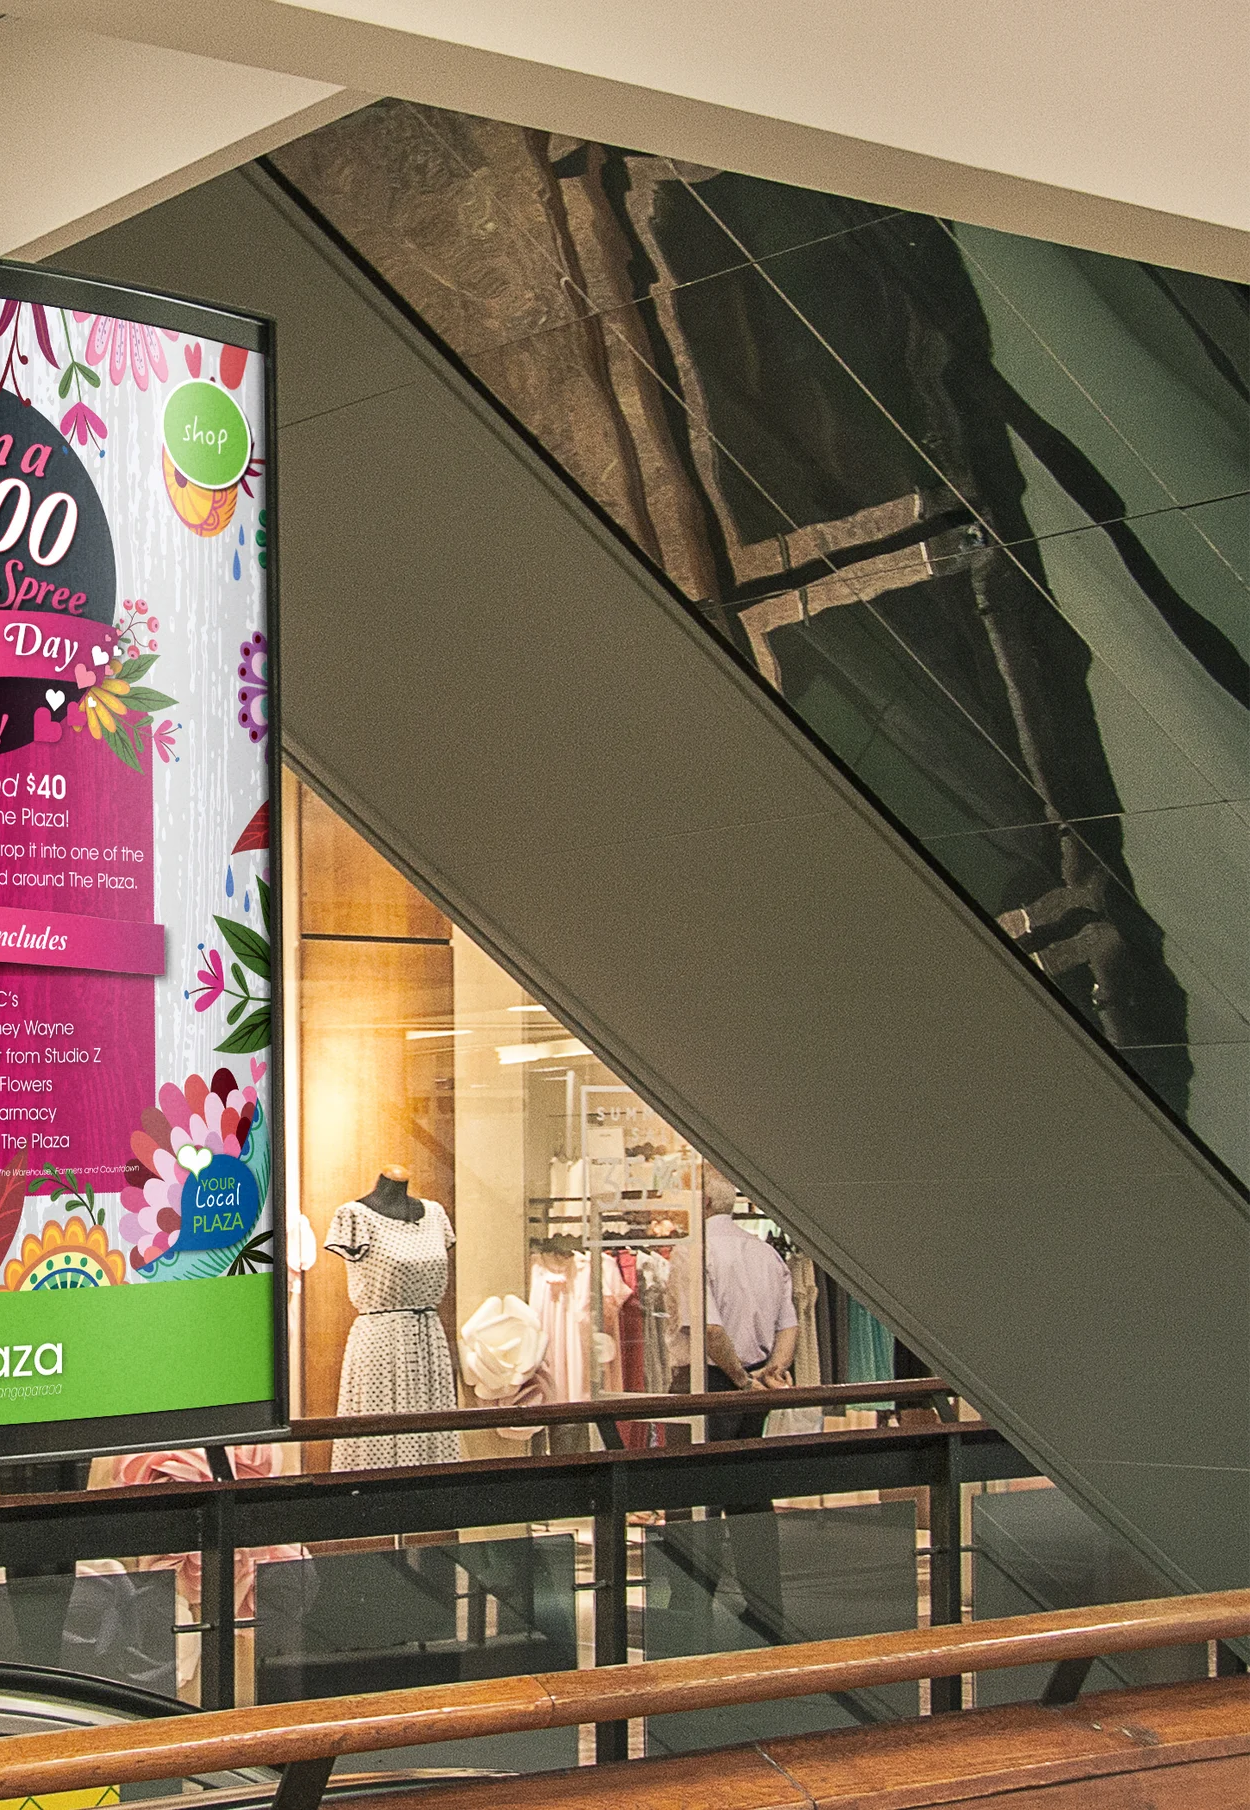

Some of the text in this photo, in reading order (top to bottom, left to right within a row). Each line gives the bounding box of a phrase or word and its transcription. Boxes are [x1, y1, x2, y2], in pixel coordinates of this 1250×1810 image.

[182, 415, 228, 455] shop
[20, 443, 52, 477] a
[4, 622, 79, 672] Day
[26, 772, 67, 800] $40
[21, 807, 69, 828] Plaza!
[29, 841, 37, 858] it
[40, 842, 67, 860] into
[70, 846, 100, 861] one
[102, 845, 119, 862] of
[120, 845, 146, 863] the
[11, 871, 65, 888] around
[68, 871, 94, 889] The
[97, 872, 138, 890] Plaza.
[23, 1019, 75, 1039] Wayne
[5, 1047, 41, 1064] from
[44, 1047, 90, 1064] Studio
[93, 1047, 102, 1063] Z
[0, 1075, 53, 1093] Flowers
[0, 1133, 28, 1150] The
[31, 1132, 70, 1149] Plaza
[0, 1168, 11, 1177] The
[55, 1167, 83, 1175] Farmers
[84, 1166, 99, 1174] and
[99, 1164, 140, 1174] Countdown
[201, 1177, 236, 1191] YOUR
[196, 1182, 242, 1208] Local
[193, 1212, 245, 1234] PLAZA
